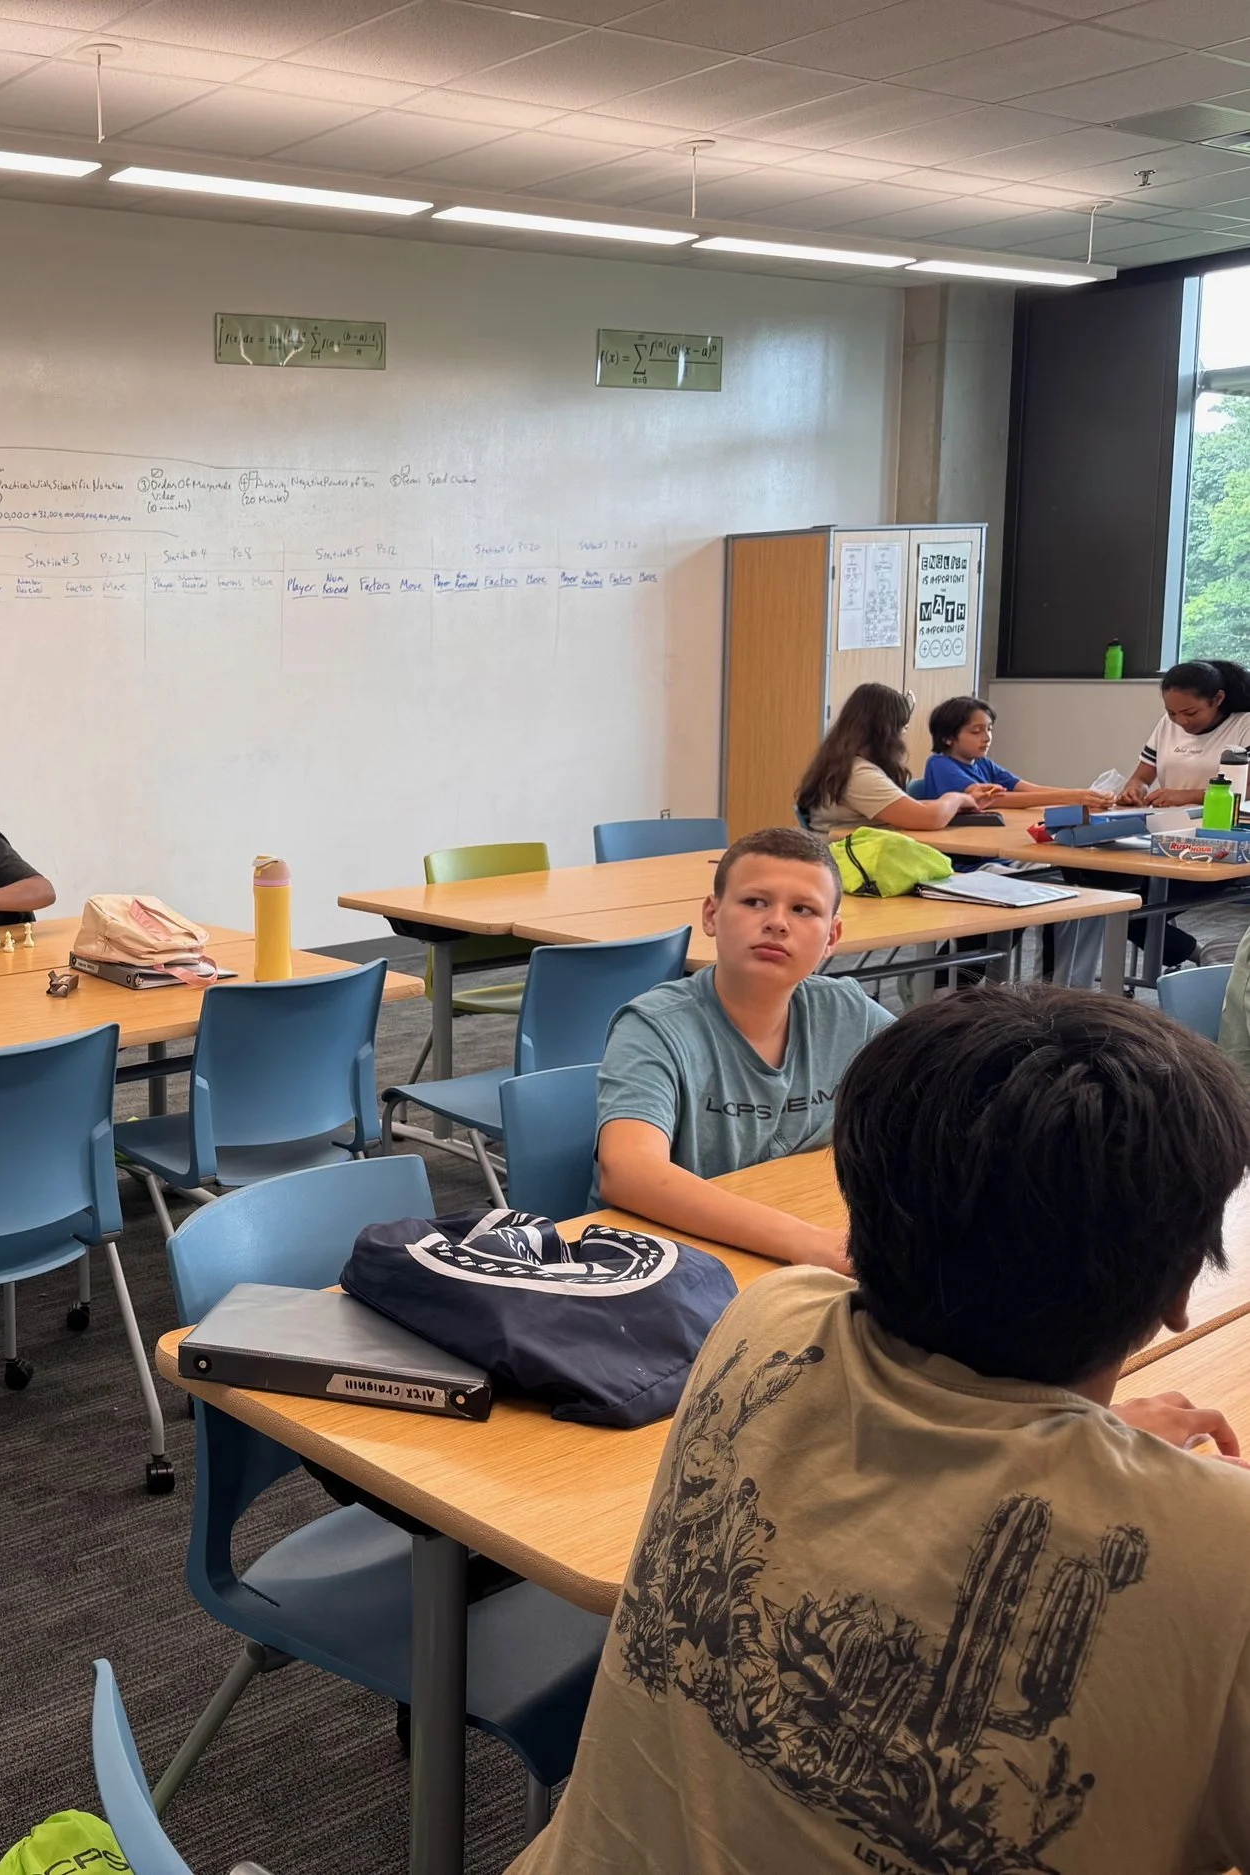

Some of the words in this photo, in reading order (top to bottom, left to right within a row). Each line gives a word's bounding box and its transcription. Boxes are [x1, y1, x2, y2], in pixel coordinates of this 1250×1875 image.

[921, 555, 967, 570] ENGLISH
[287, 579, 316, 593] Player
[359, 577, 391, 592] Factors
[483, 572, 519, 586] Factors
[922, 575, 929, 585] IS
[930, 573, 965, 584] IMPORTANT
[919, 594, 966, 623] MATH
[919, 626, 925, 636] IS
[925, 623, 965, 635] IMPORTANTER
[705, 1097, 772, 1120] LCPS
